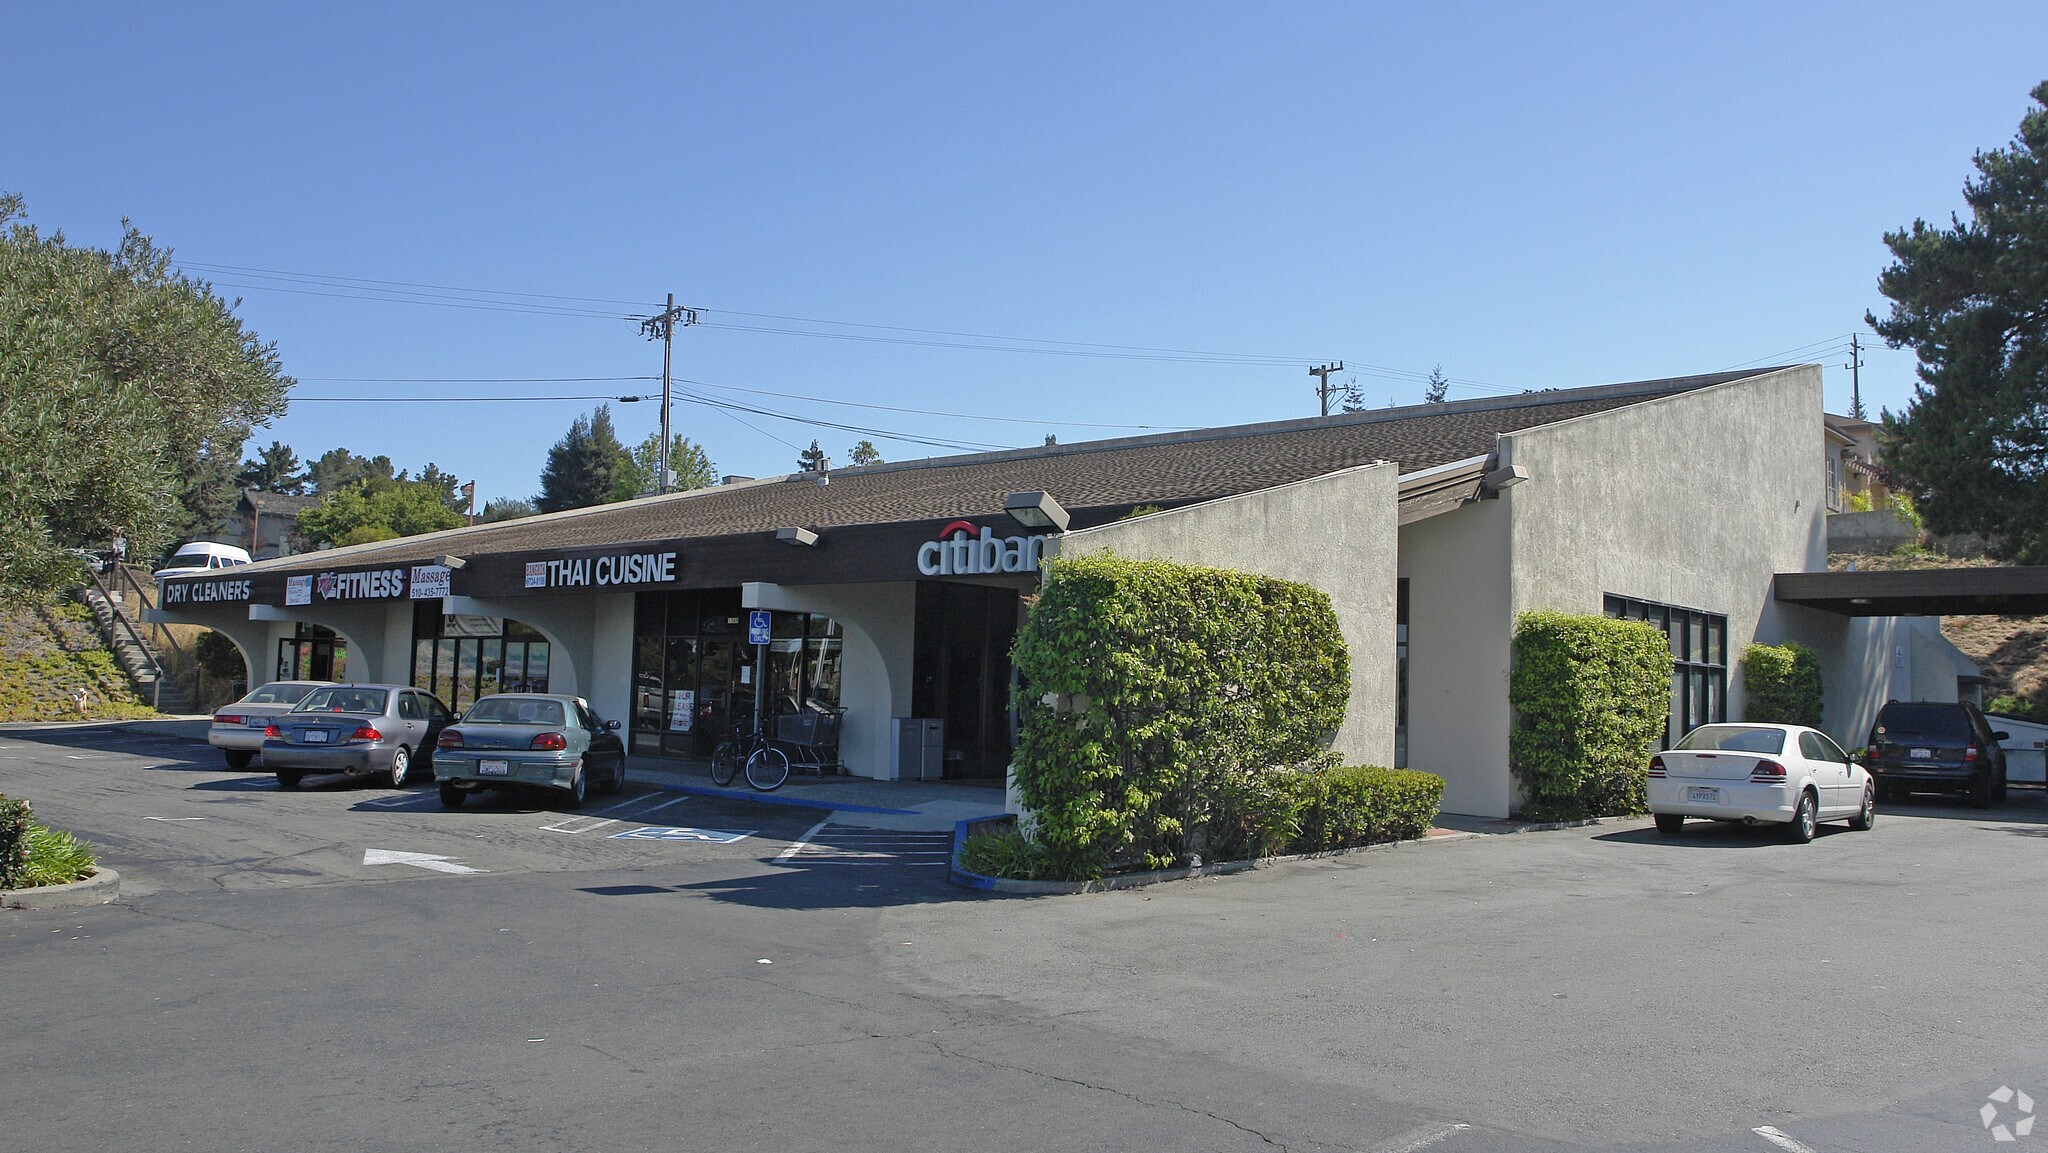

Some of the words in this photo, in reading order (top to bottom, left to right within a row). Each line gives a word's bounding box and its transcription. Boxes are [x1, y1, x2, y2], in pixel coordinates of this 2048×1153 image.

[917, 525, 1044, 576] citiban
[412, 567, 450, 585] Massage
[548, 558, 591, 587] THAI
[596, 552, 677, 586] CUISINE
[167, 584, 188, 603] DRY
[192, 580, 250, 602] CLEANERS
[337, 569, 403, 599] FITNESS
[411, 587, 449, 598] 510-435-7772
